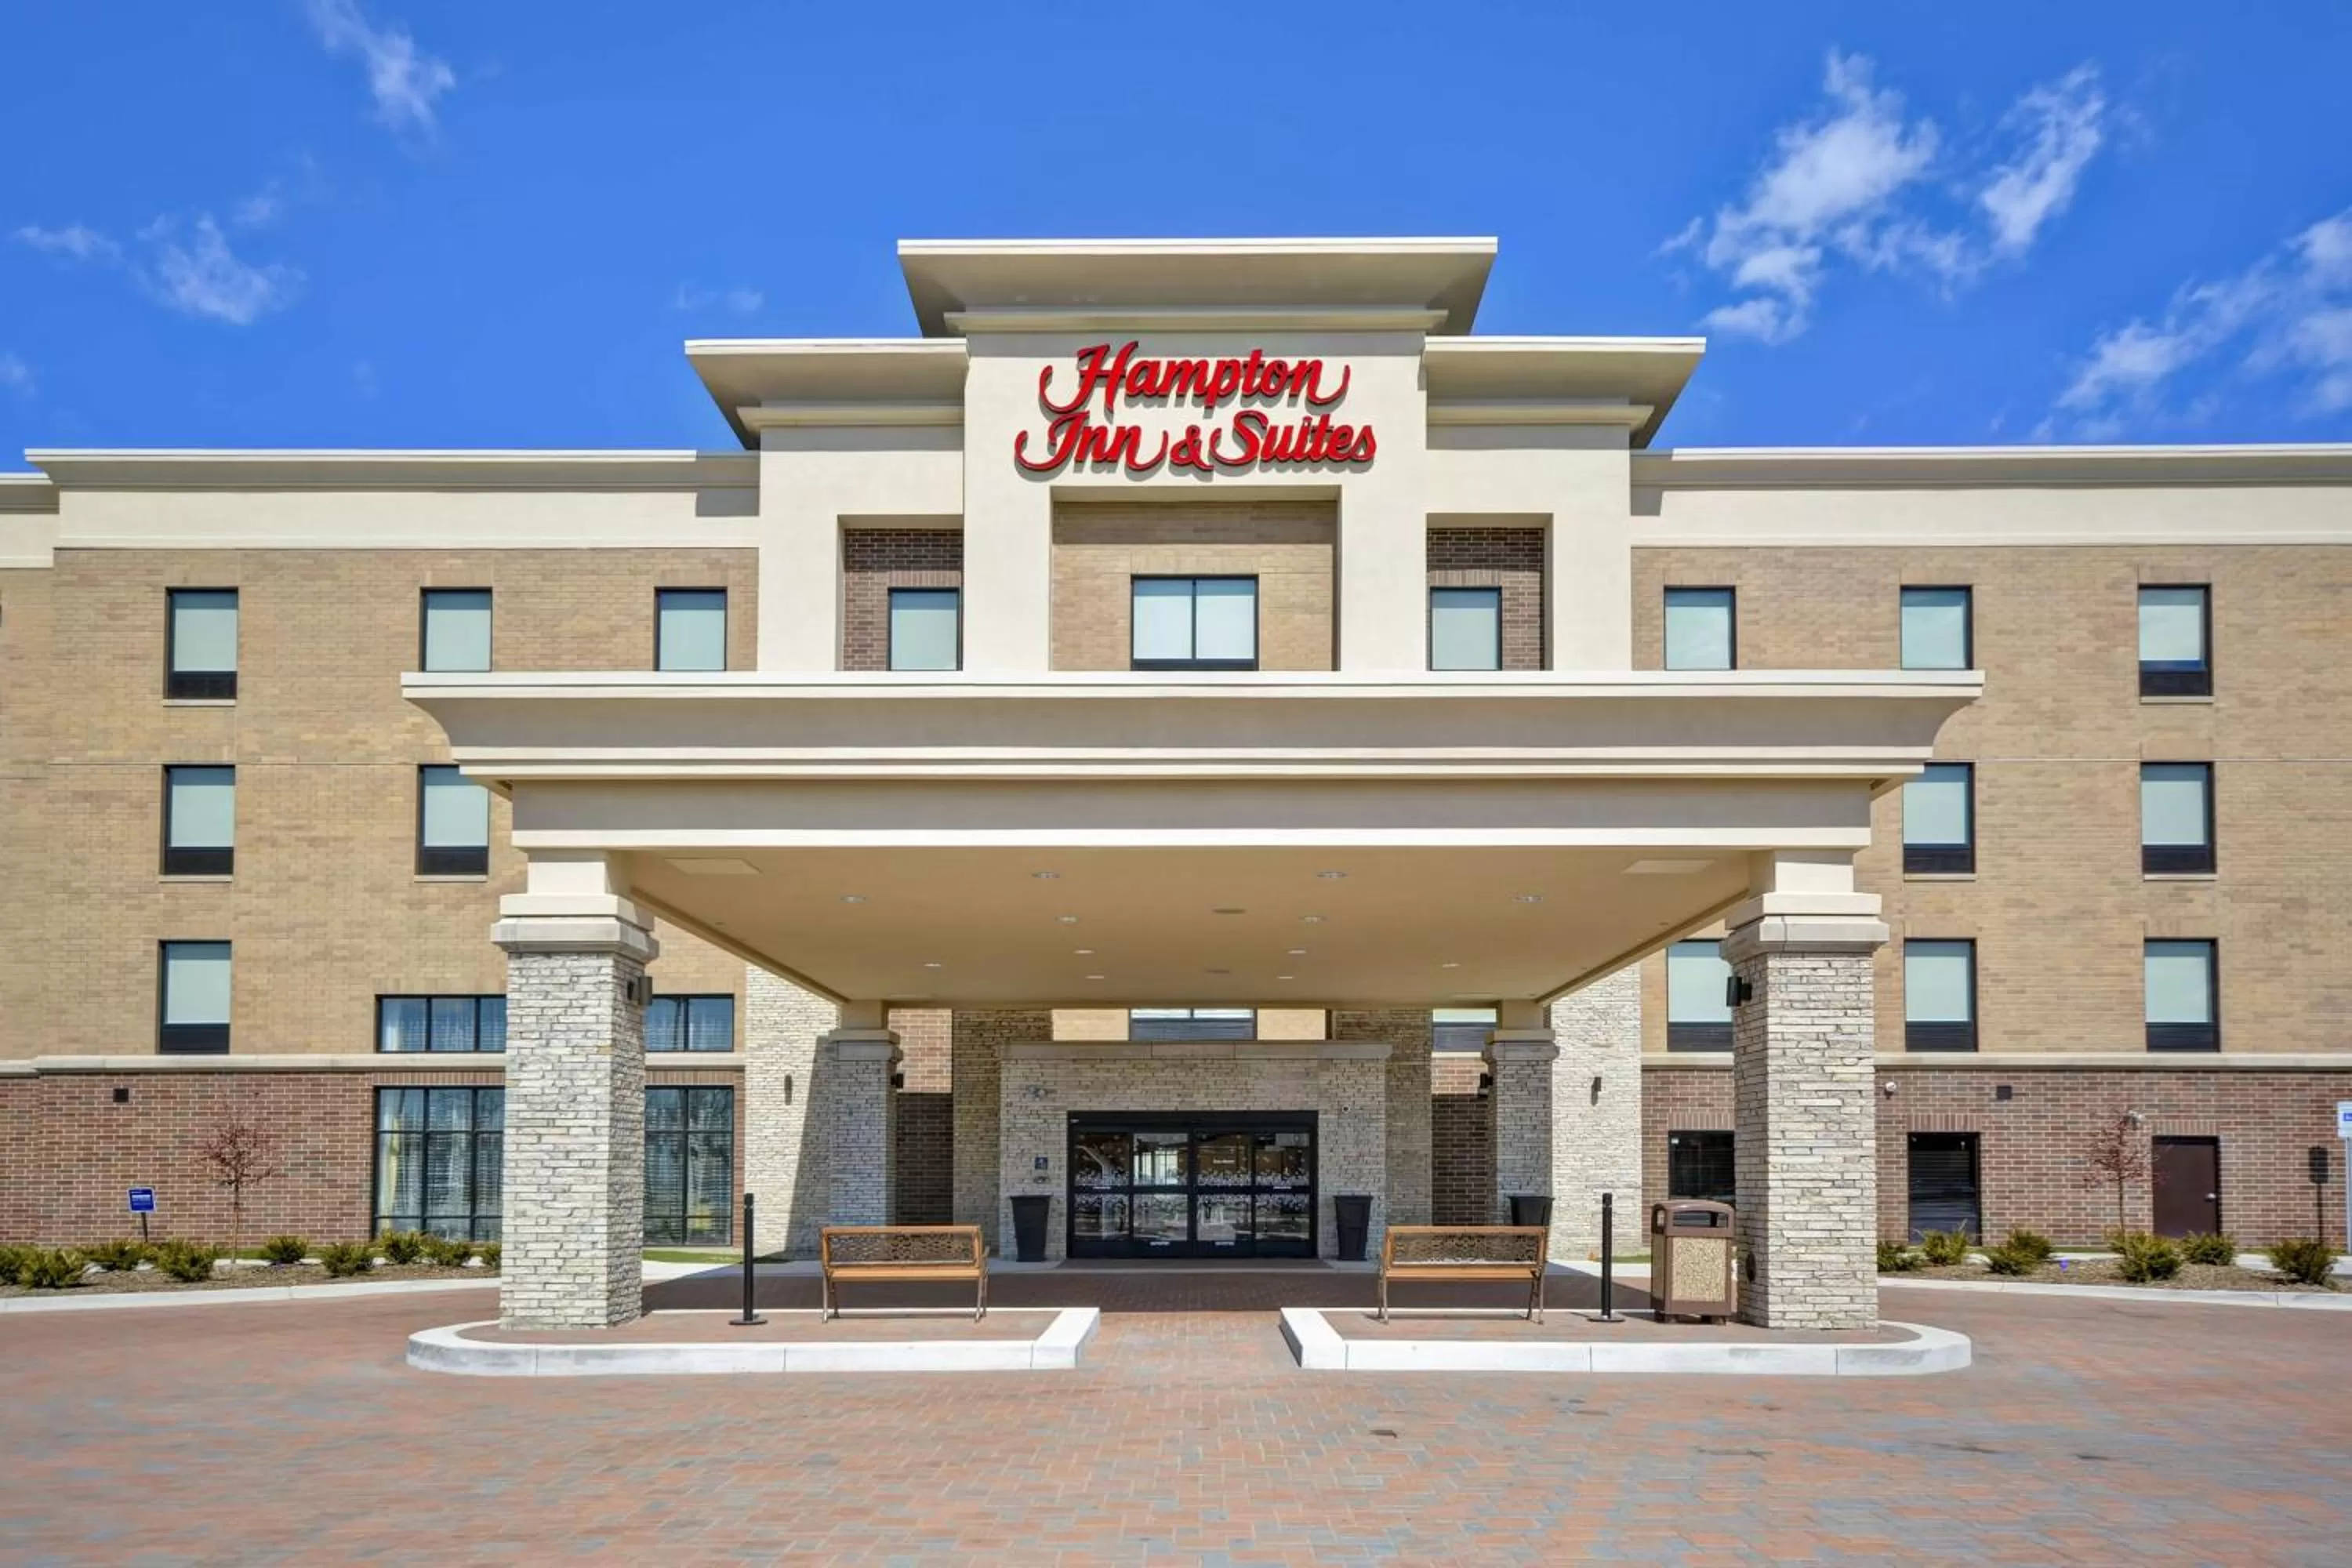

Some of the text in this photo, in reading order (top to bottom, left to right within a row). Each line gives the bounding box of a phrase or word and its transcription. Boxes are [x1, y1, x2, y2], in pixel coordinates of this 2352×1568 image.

[1039, 341, 1351, 413] Hampton
[1014, 409, 1377, 470] Inn & Suites
